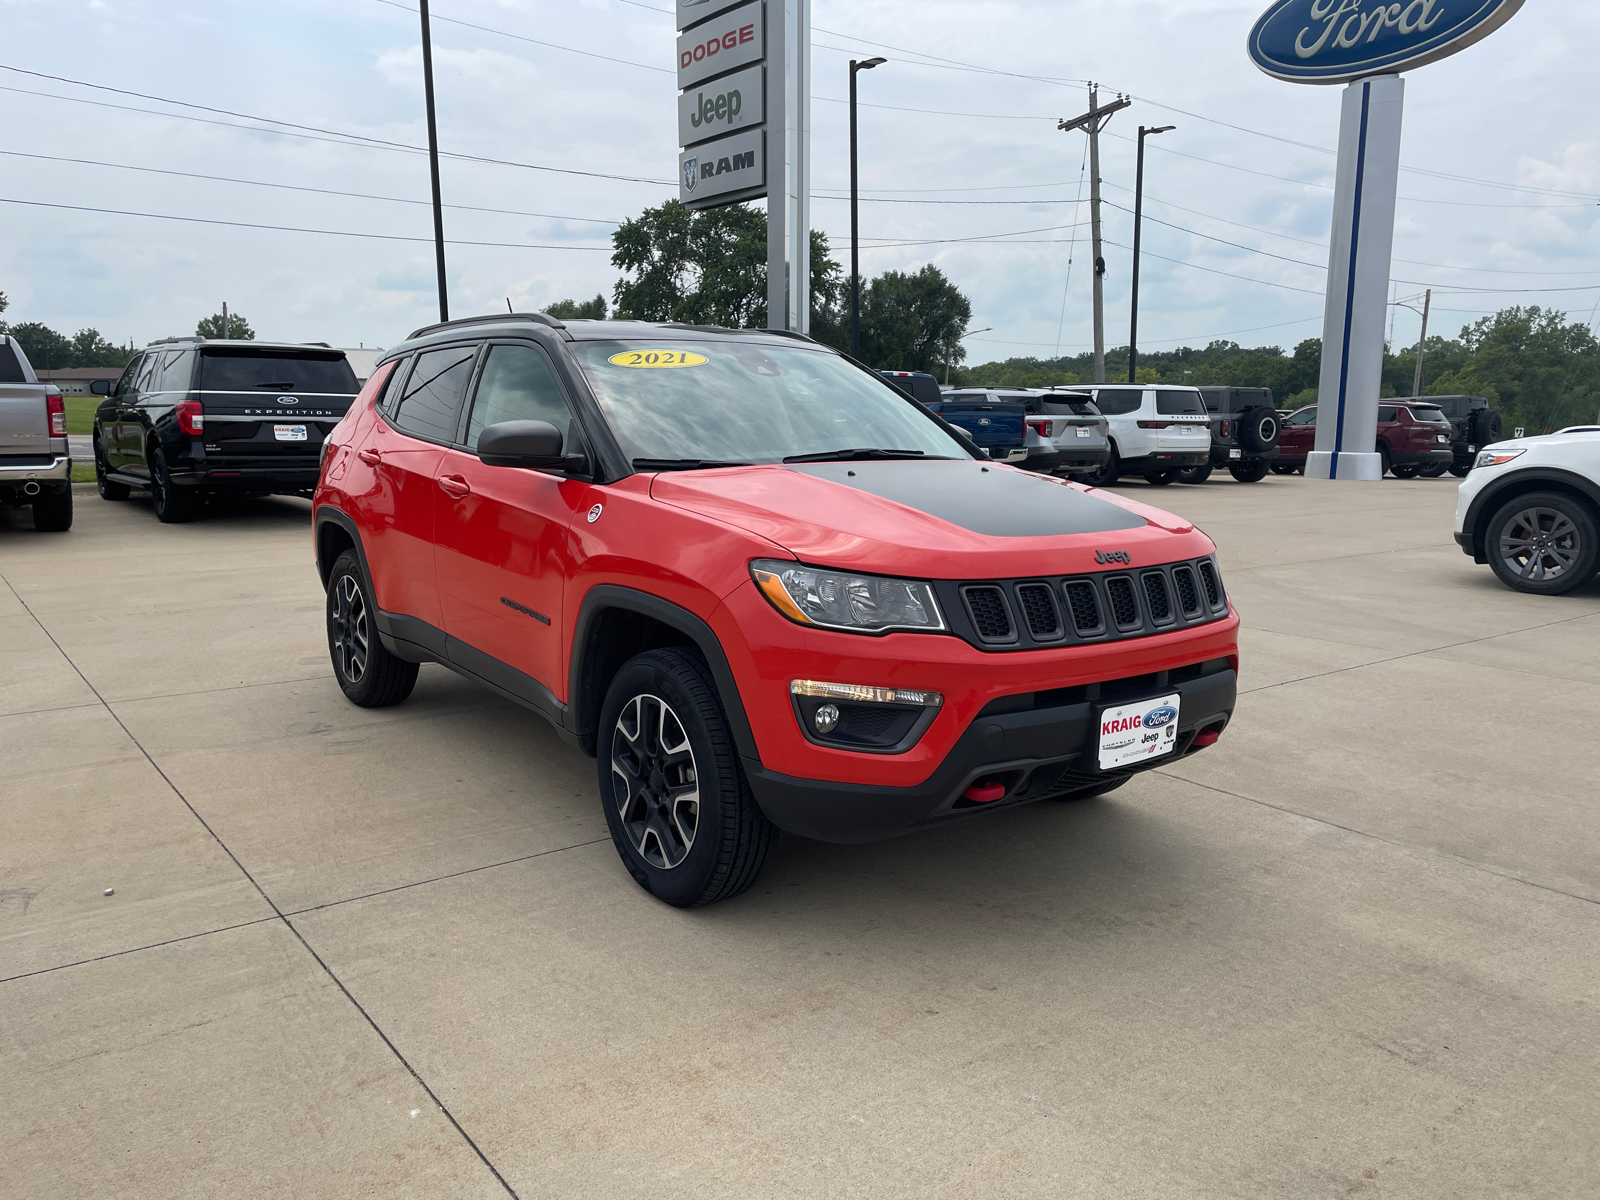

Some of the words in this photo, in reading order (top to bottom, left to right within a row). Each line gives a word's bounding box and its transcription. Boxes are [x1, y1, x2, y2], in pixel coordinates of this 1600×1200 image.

[1295, 0, 1445, 59] Ford
[680, 24, 754, 69] DODGE
[691, 89, 742, 128] Jeep
[700, 150, 755, 180] RAM
[629, 352, 688, 365] 2021
[1094, 549, 1131, 565] Jeep
[1102, 715, 1142, 735] KRAIG
[1148, 710, 1172, 726] Ford
[1141, 733, 1159, 744] Jeep
